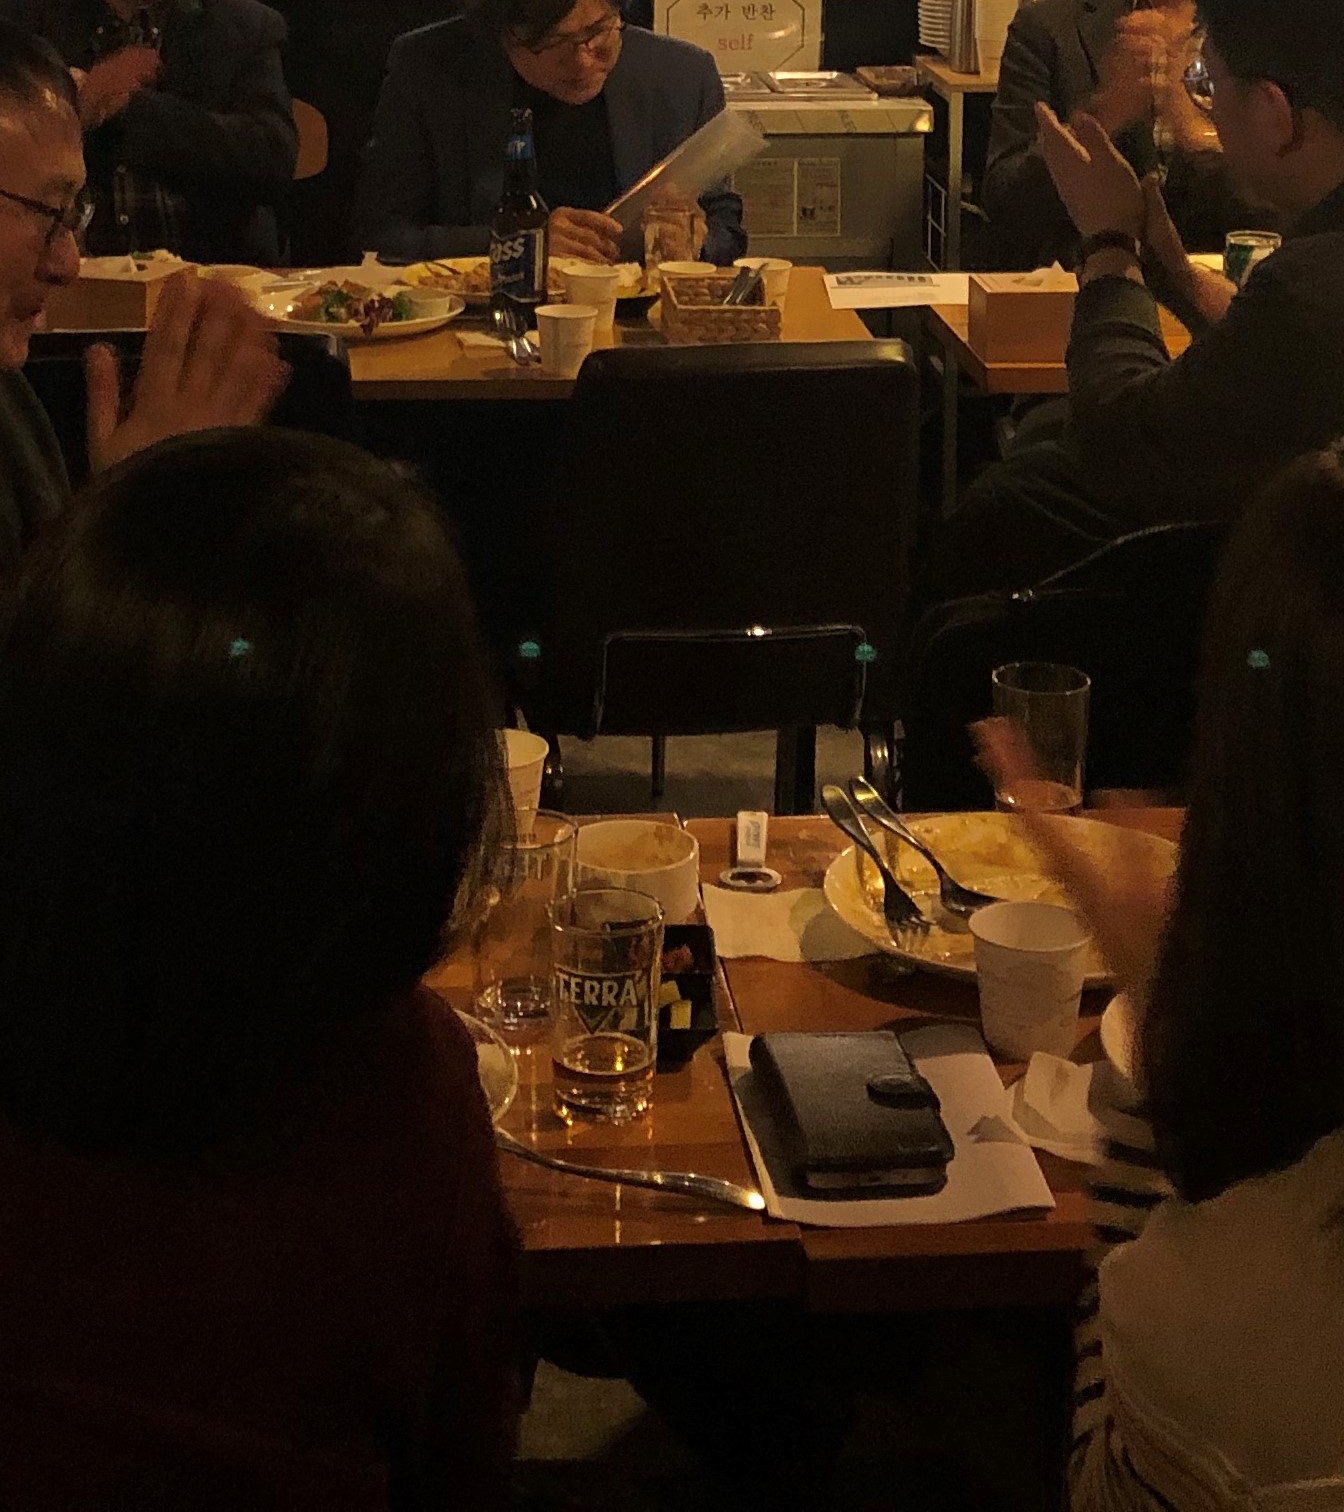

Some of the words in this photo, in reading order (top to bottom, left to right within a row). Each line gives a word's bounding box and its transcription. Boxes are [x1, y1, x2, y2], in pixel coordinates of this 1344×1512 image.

[696, 2, 731, 21] 추가
[741, 2, 776, 21] 반찬
[717, 33, 754, 51] self
[555, 971, 638, 1007] TERRA
